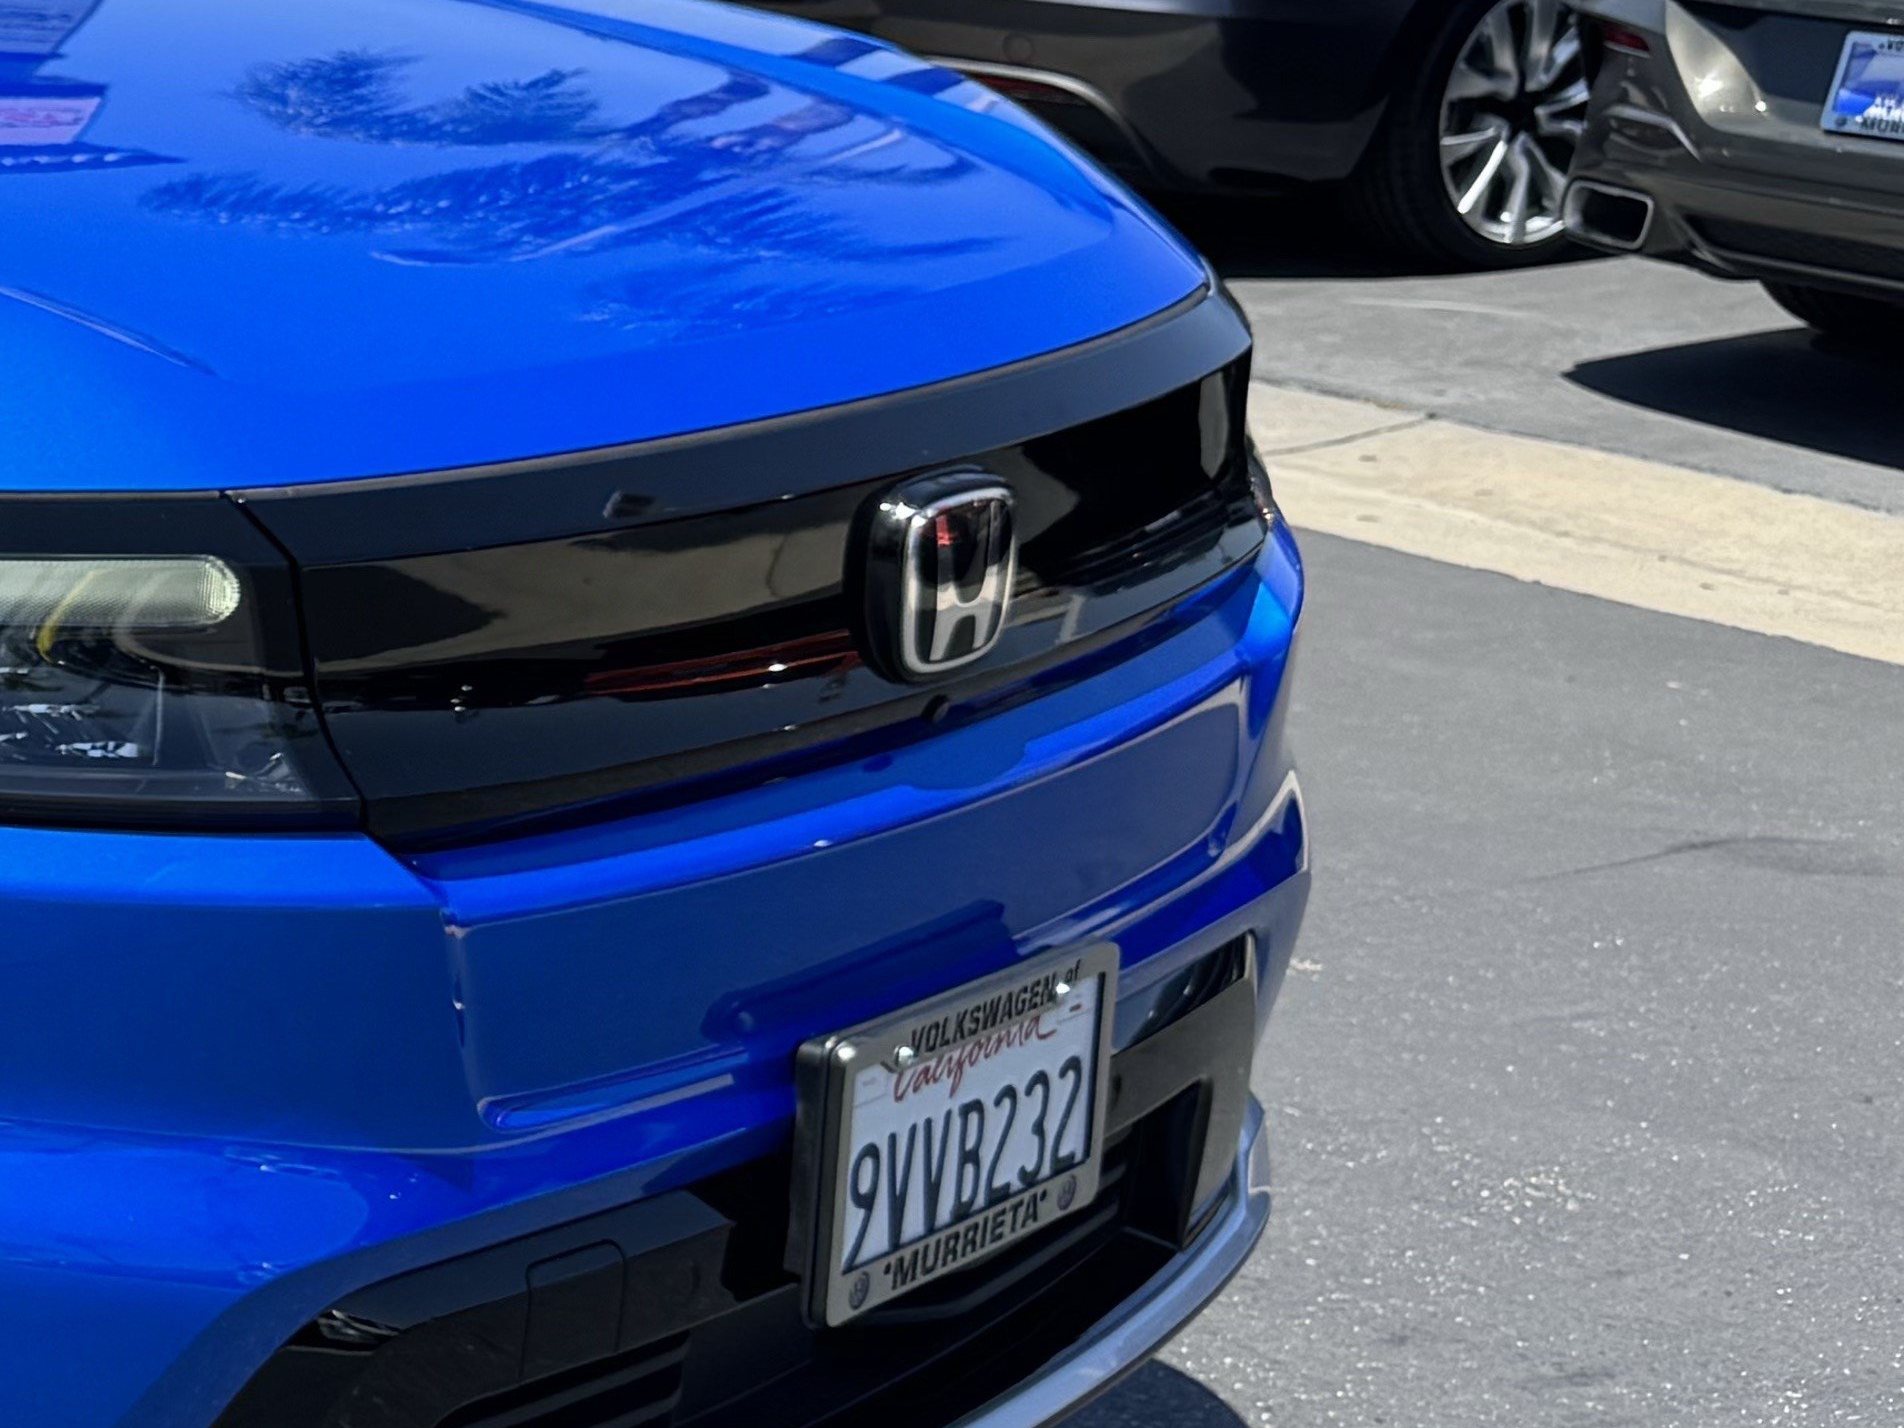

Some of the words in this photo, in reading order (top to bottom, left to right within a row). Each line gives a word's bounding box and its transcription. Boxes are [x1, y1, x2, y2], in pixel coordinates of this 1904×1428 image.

[911, 980, 1057, 1057] VOLKSWAGEN
[1064, 957, 1082, 986] of
[893, 1011, 1058, 1104] California
[843, 1054, 1084, 1272] 9VVB232
[891, 1196, 1042, 1291] MURRIETA
